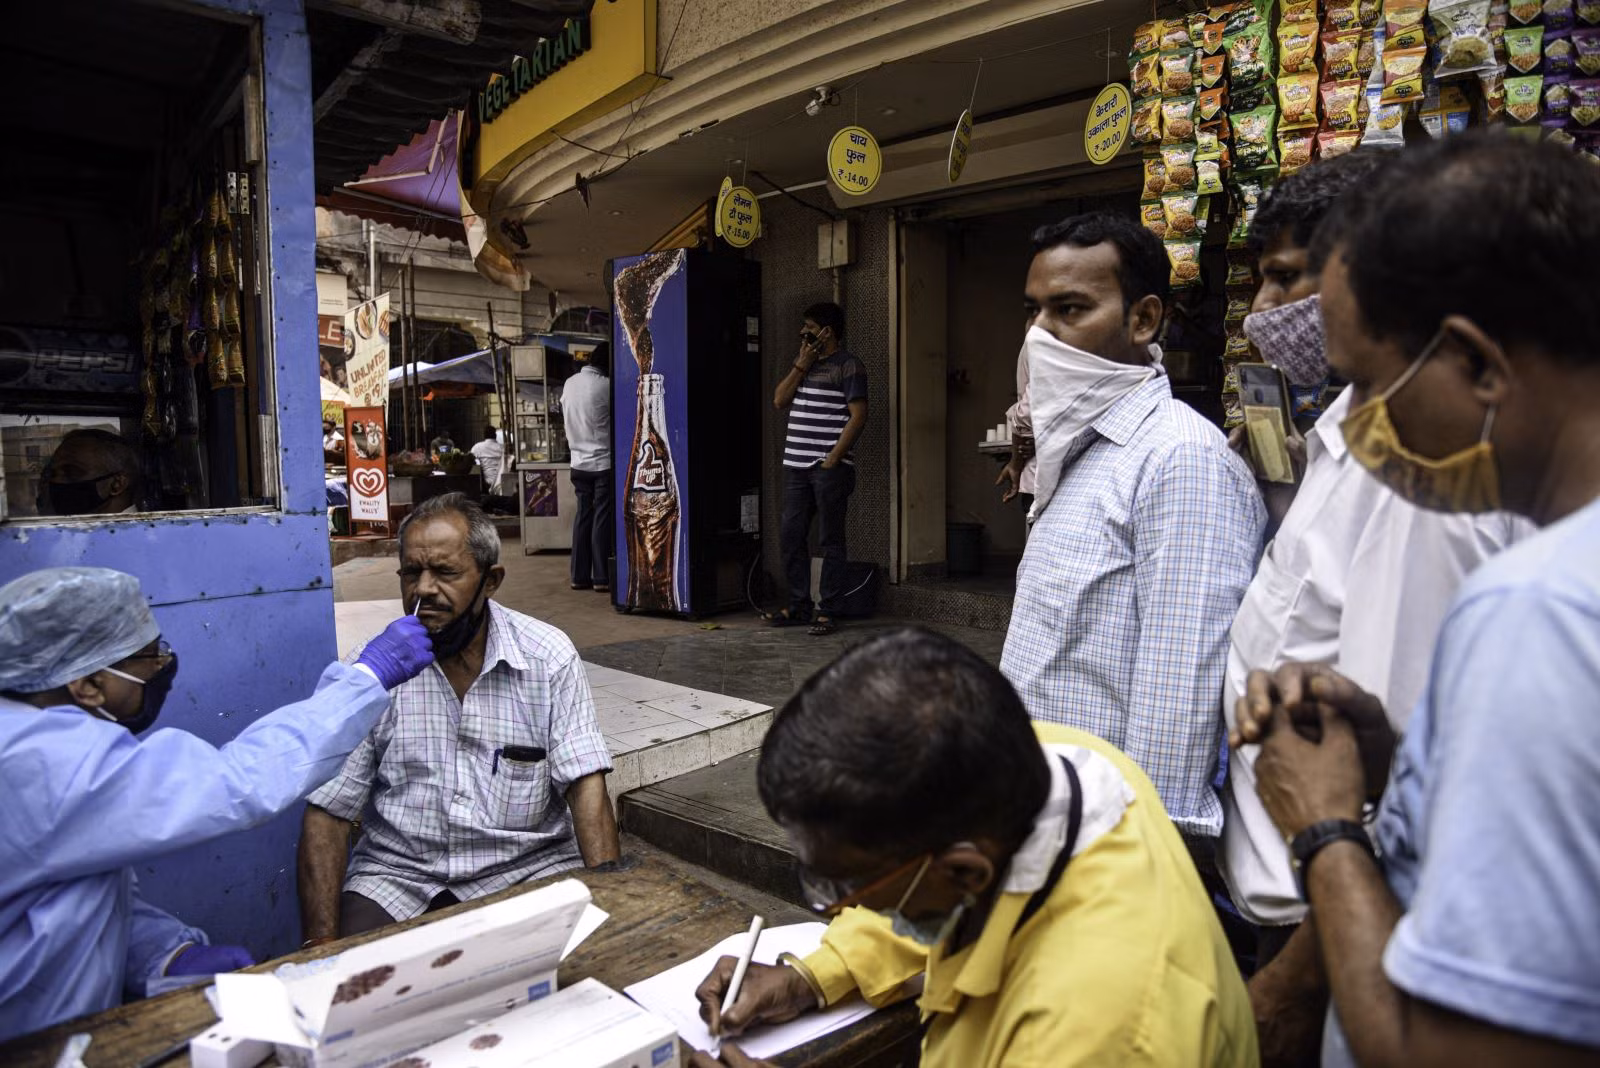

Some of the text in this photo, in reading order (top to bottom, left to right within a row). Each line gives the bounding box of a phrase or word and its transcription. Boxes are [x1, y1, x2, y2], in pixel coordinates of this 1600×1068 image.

[479, 19, 581, 123] VEGETARIAN
[1111, 106, 1127, 128] फुल
[850, 133, 868, 147] चाय
[846, 148, 866, 165] फुल
[734, 193, 753, 210] लेमन
[729, 207, 753, 226] टी फुल
[35, 349, 135, 373] PEPSI
[350, 349, 386, 384] UNLIMITED
[639, 467, 661, 477] Thums
